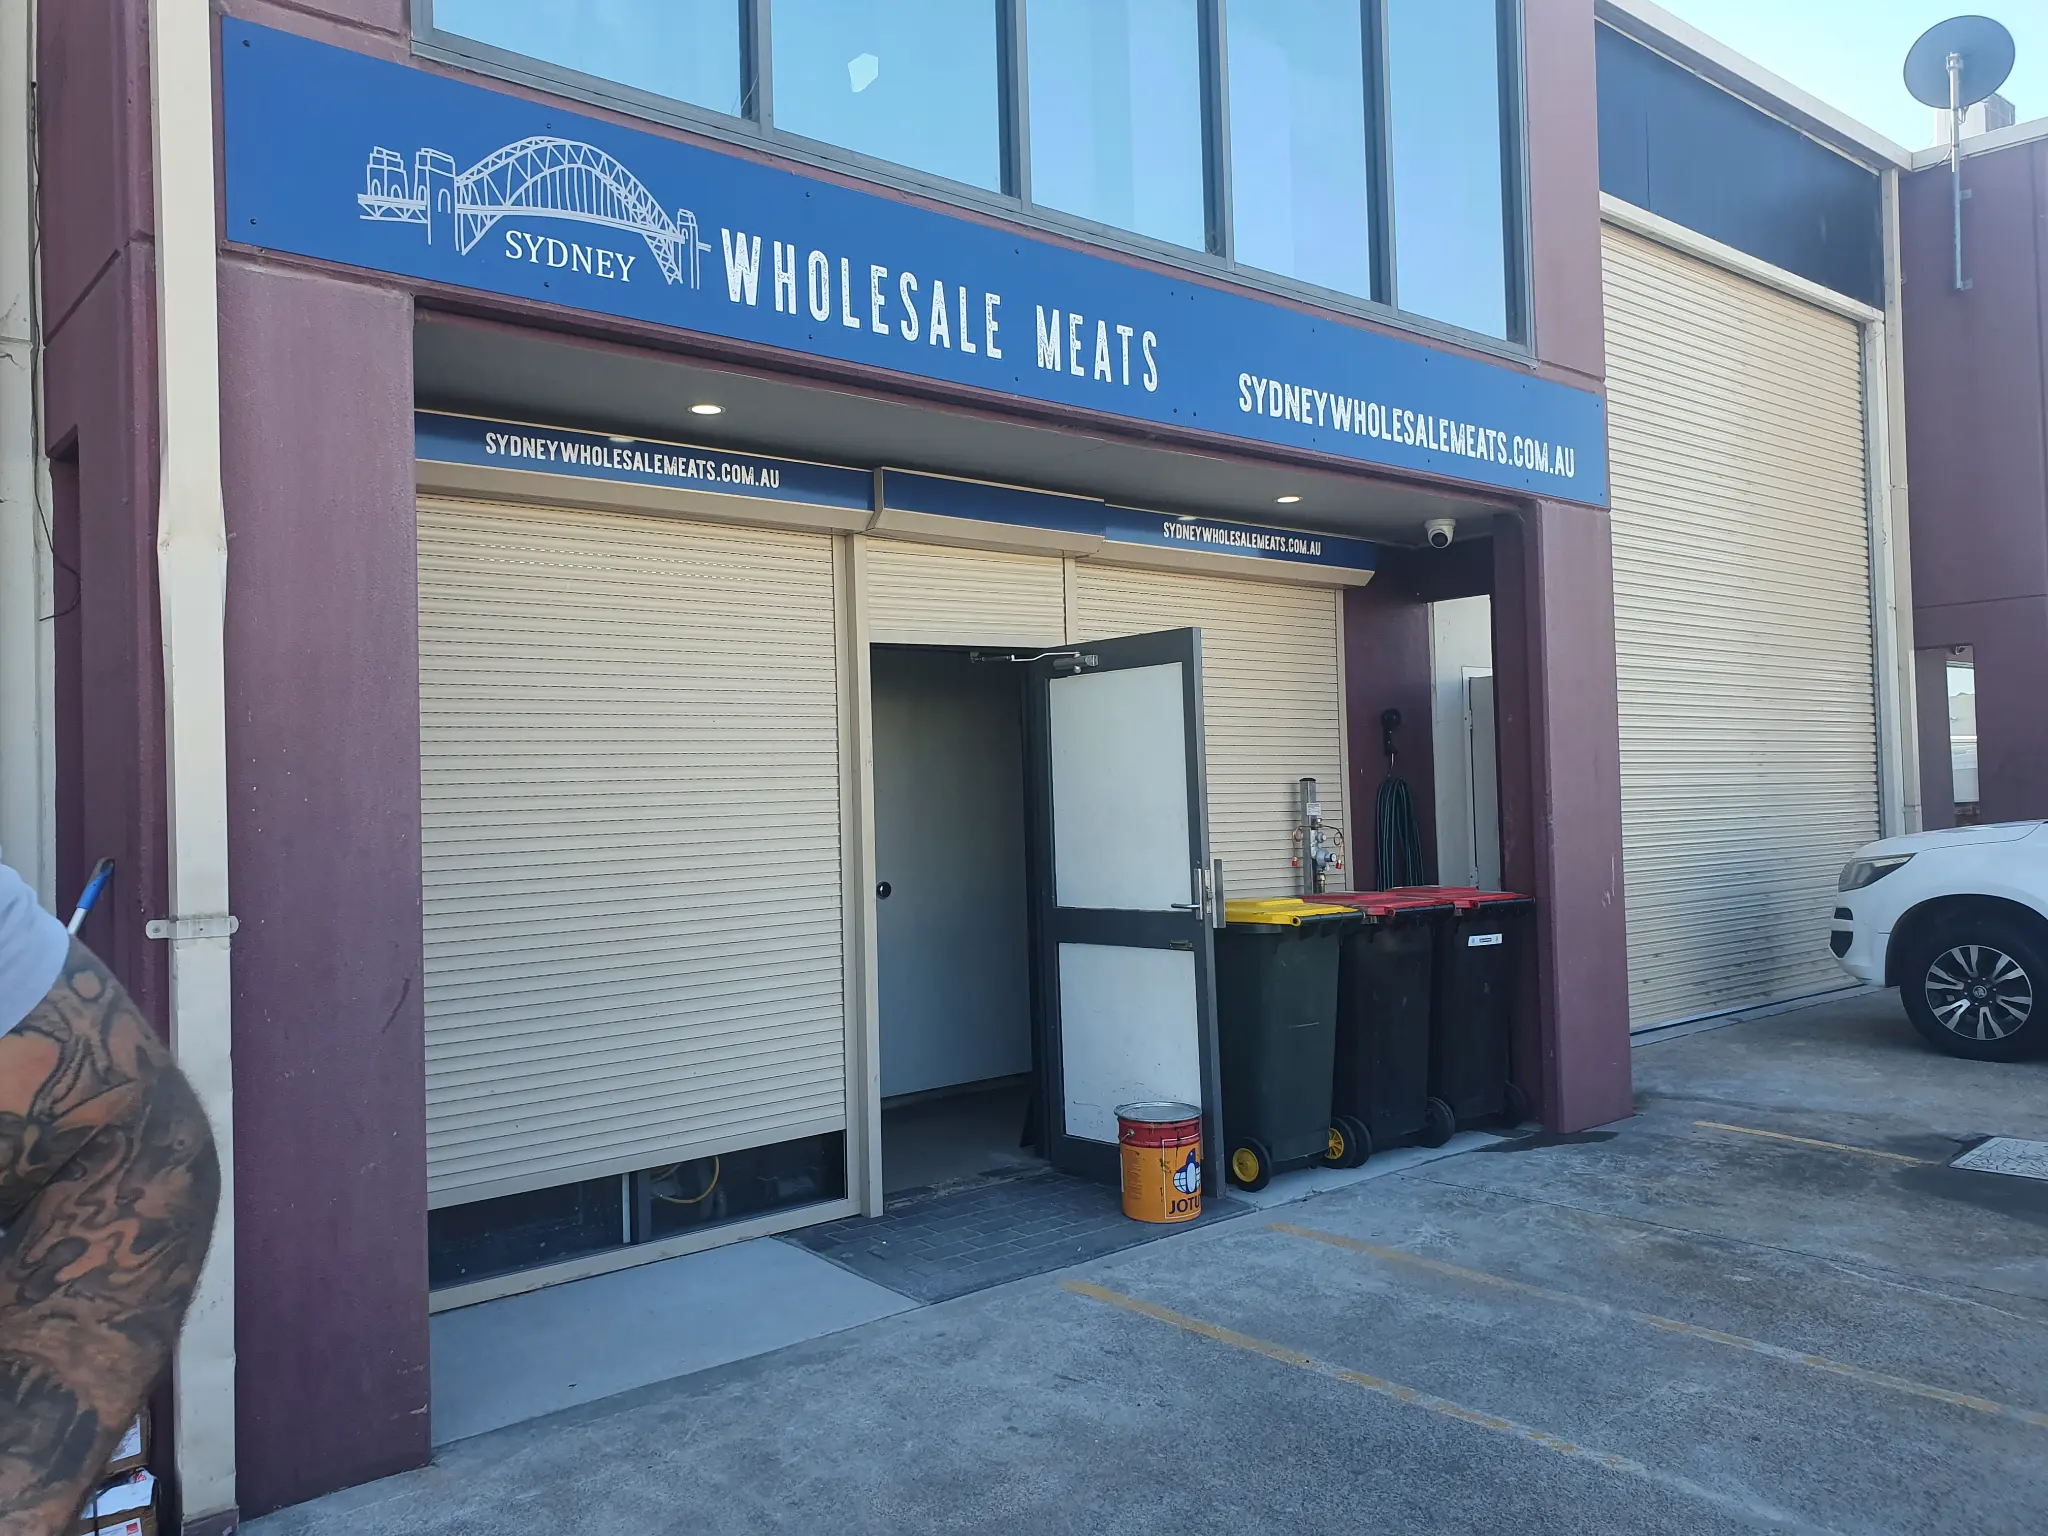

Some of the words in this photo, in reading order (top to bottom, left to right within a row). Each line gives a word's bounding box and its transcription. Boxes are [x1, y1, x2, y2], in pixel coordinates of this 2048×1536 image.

[505, 229, 636, 282] SYDNEY
[721, 228, 1002, 359] WHOLESALE
[1036, 305, 1158, 393] MEATS
[1238, 372, 1576, 478] SYDNEYWHOLESALEMEATS.COM.AU
[485, 432, 780, 489] SYDNEYWHOLESALEMEATS.COM.AU
[1163, 521, 1321, 556] SYDNEYWHOLESALEMEATS.COM.AU
